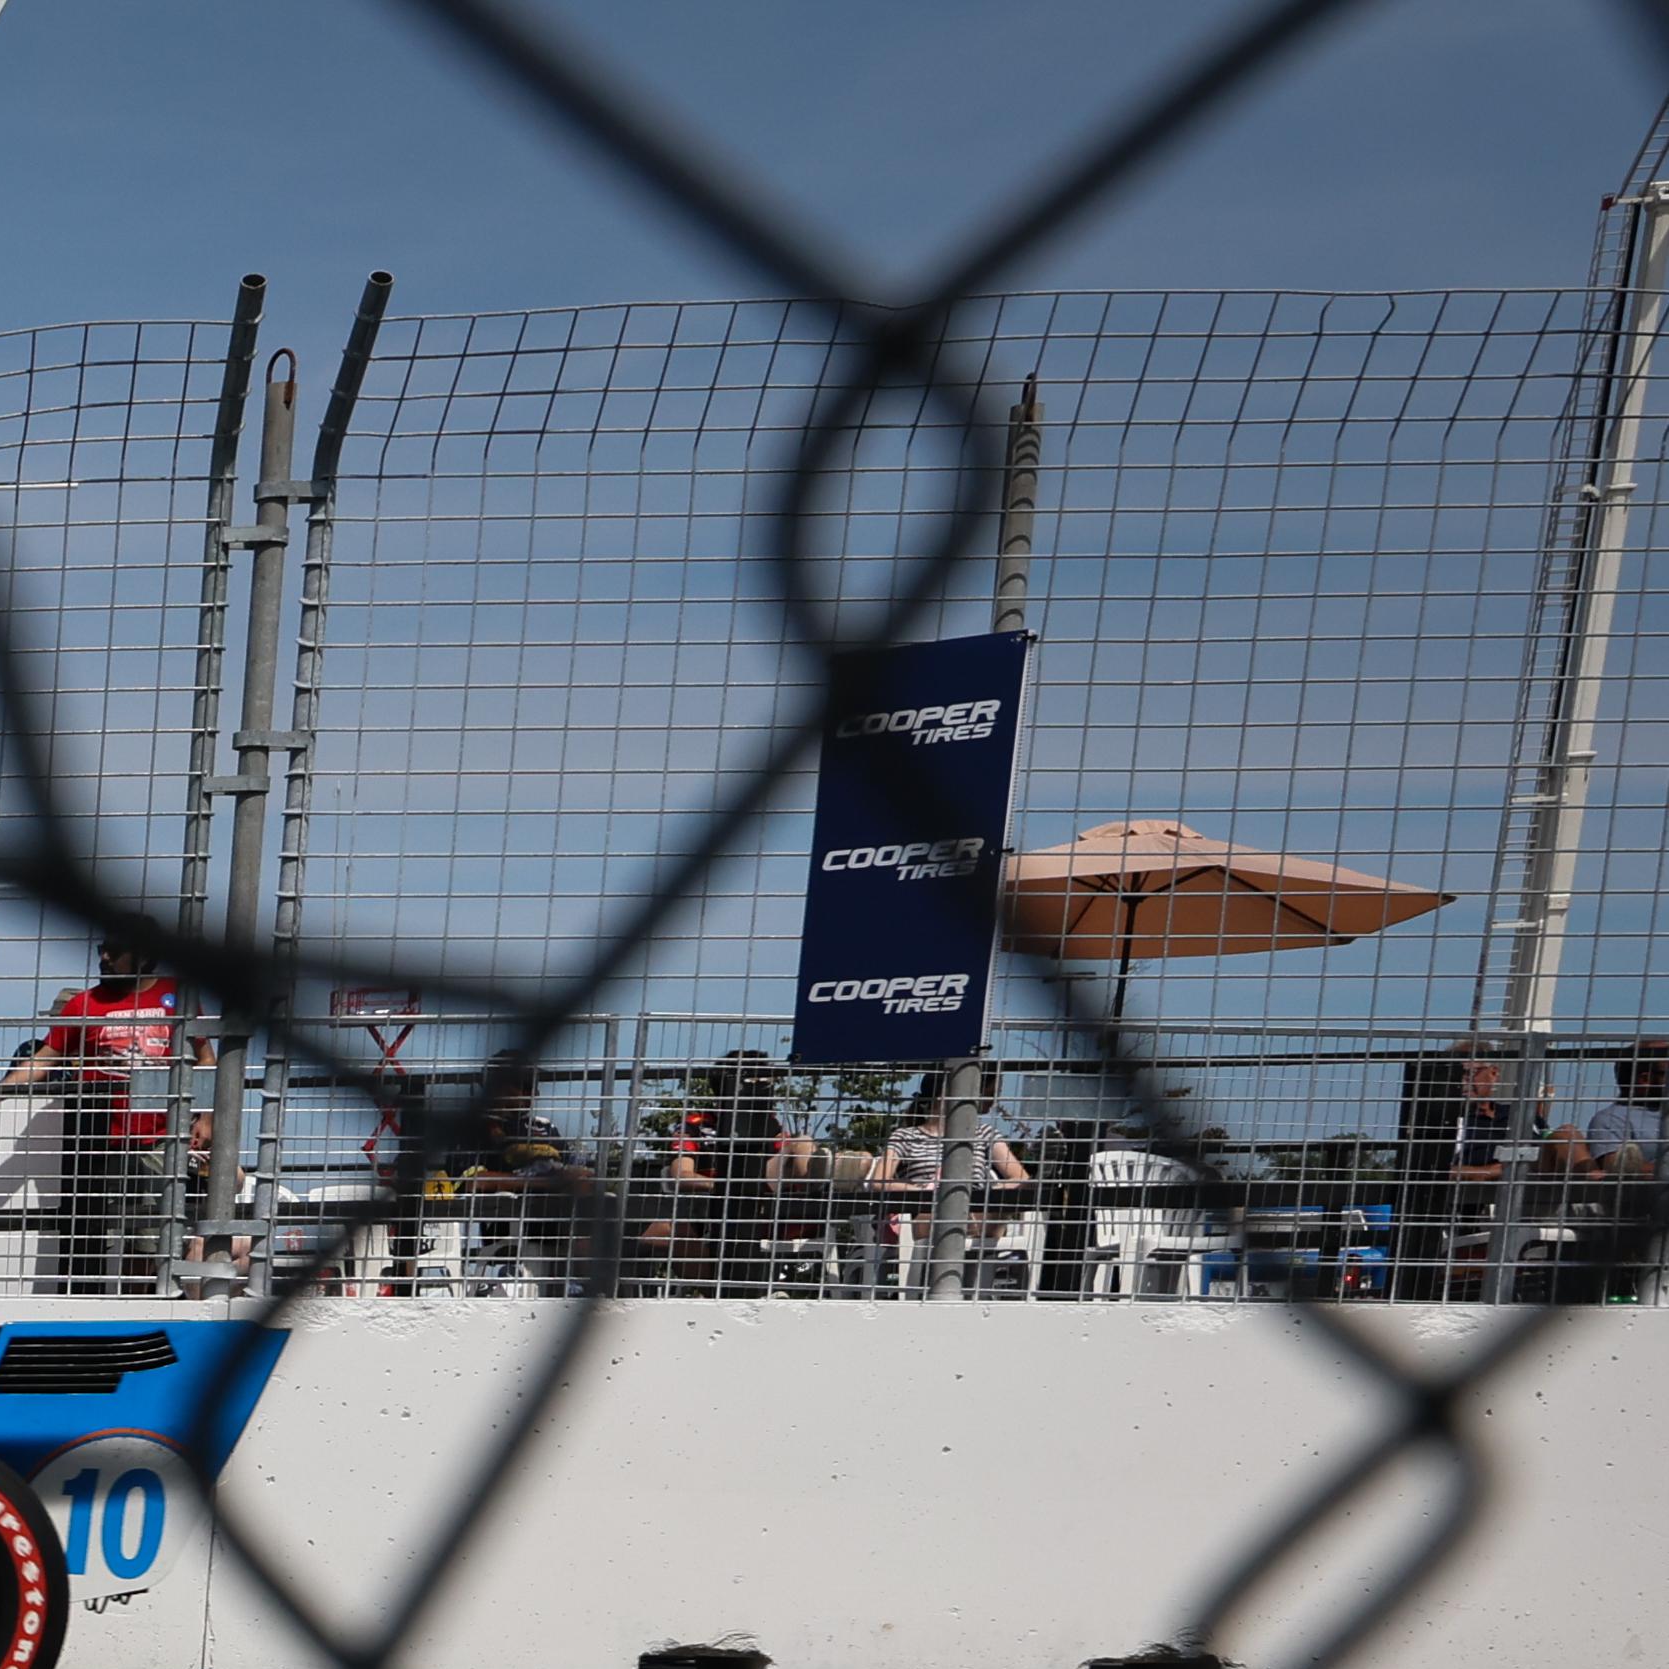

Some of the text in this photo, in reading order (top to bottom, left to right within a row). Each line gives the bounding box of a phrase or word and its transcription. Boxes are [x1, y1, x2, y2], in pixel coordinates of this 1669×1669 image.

[836, 700, 1001, 738] COOPER
[912, 721, 998, 745] TIRES
[822, 838, 985, 871] COOPER
[896, 860, 978, 880] TIRES
[808, 973, 970, 1003] COOPER
[882, 996, 963, 1015] TIRES
[62, 1468, 166, 1579] 10
